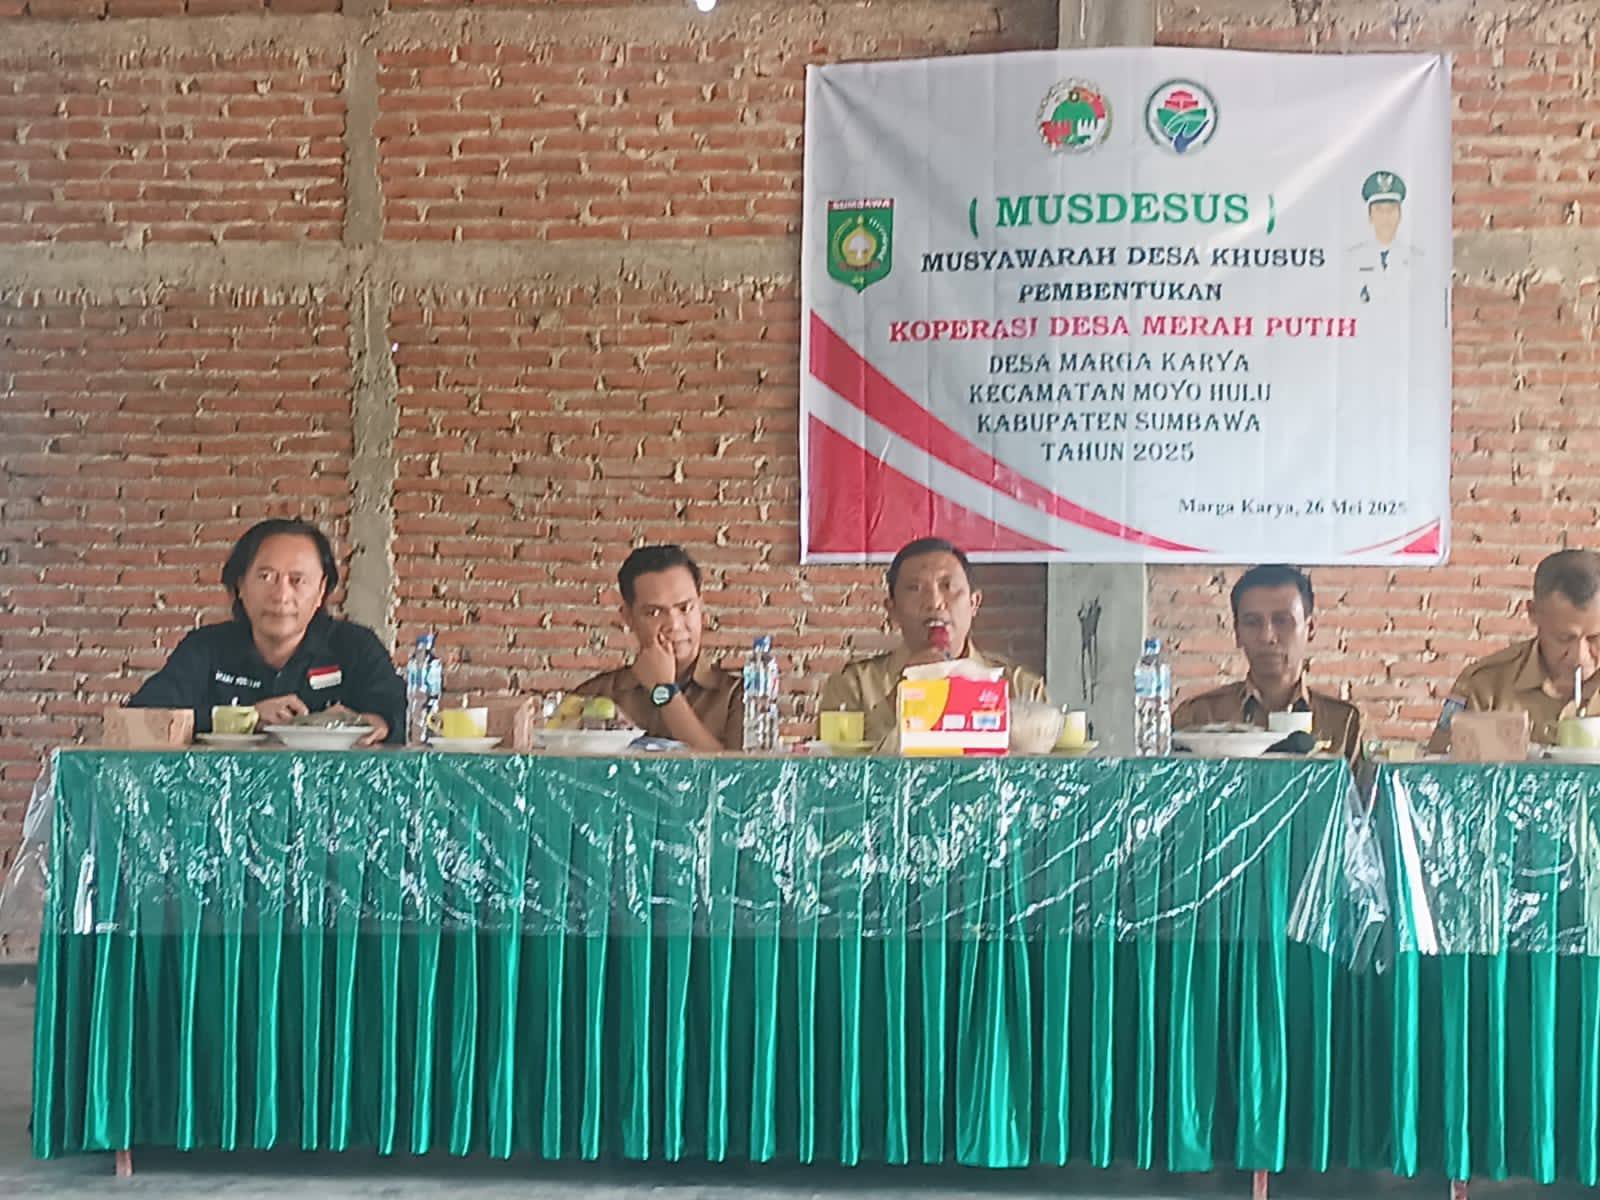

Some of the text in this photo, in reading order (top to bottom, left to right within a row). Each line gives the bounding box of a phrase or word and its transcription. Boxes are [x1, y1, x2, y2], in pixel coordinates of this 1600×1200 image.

[996, 193, 1249, 227] MUSDESUS
[921, 246, 1326, 272] MUSYAWARAH DESA KHUSUS
[1018, 282, 1223, 303] PEMBENTUKAN
[889, 315, 1358, 342] KOPERASI DESA MERAH PUTIH
[989, 349, 1250, 374] DESA MARGA KARYA
[969, 379, 1272, 404] KECAMATAN MOYO HULU
[976, 410, 1261, 434] KABUPATEN SUMBAWA
[1040, 441, 1195, 462] TAHUN 2025
[1179, 499, 1235, 519] Marga
[1241, 499, 1300, 519] Karya,
[1305, 499, 1325, 516] 26
[1331, 499, 1363, 516] Mei
